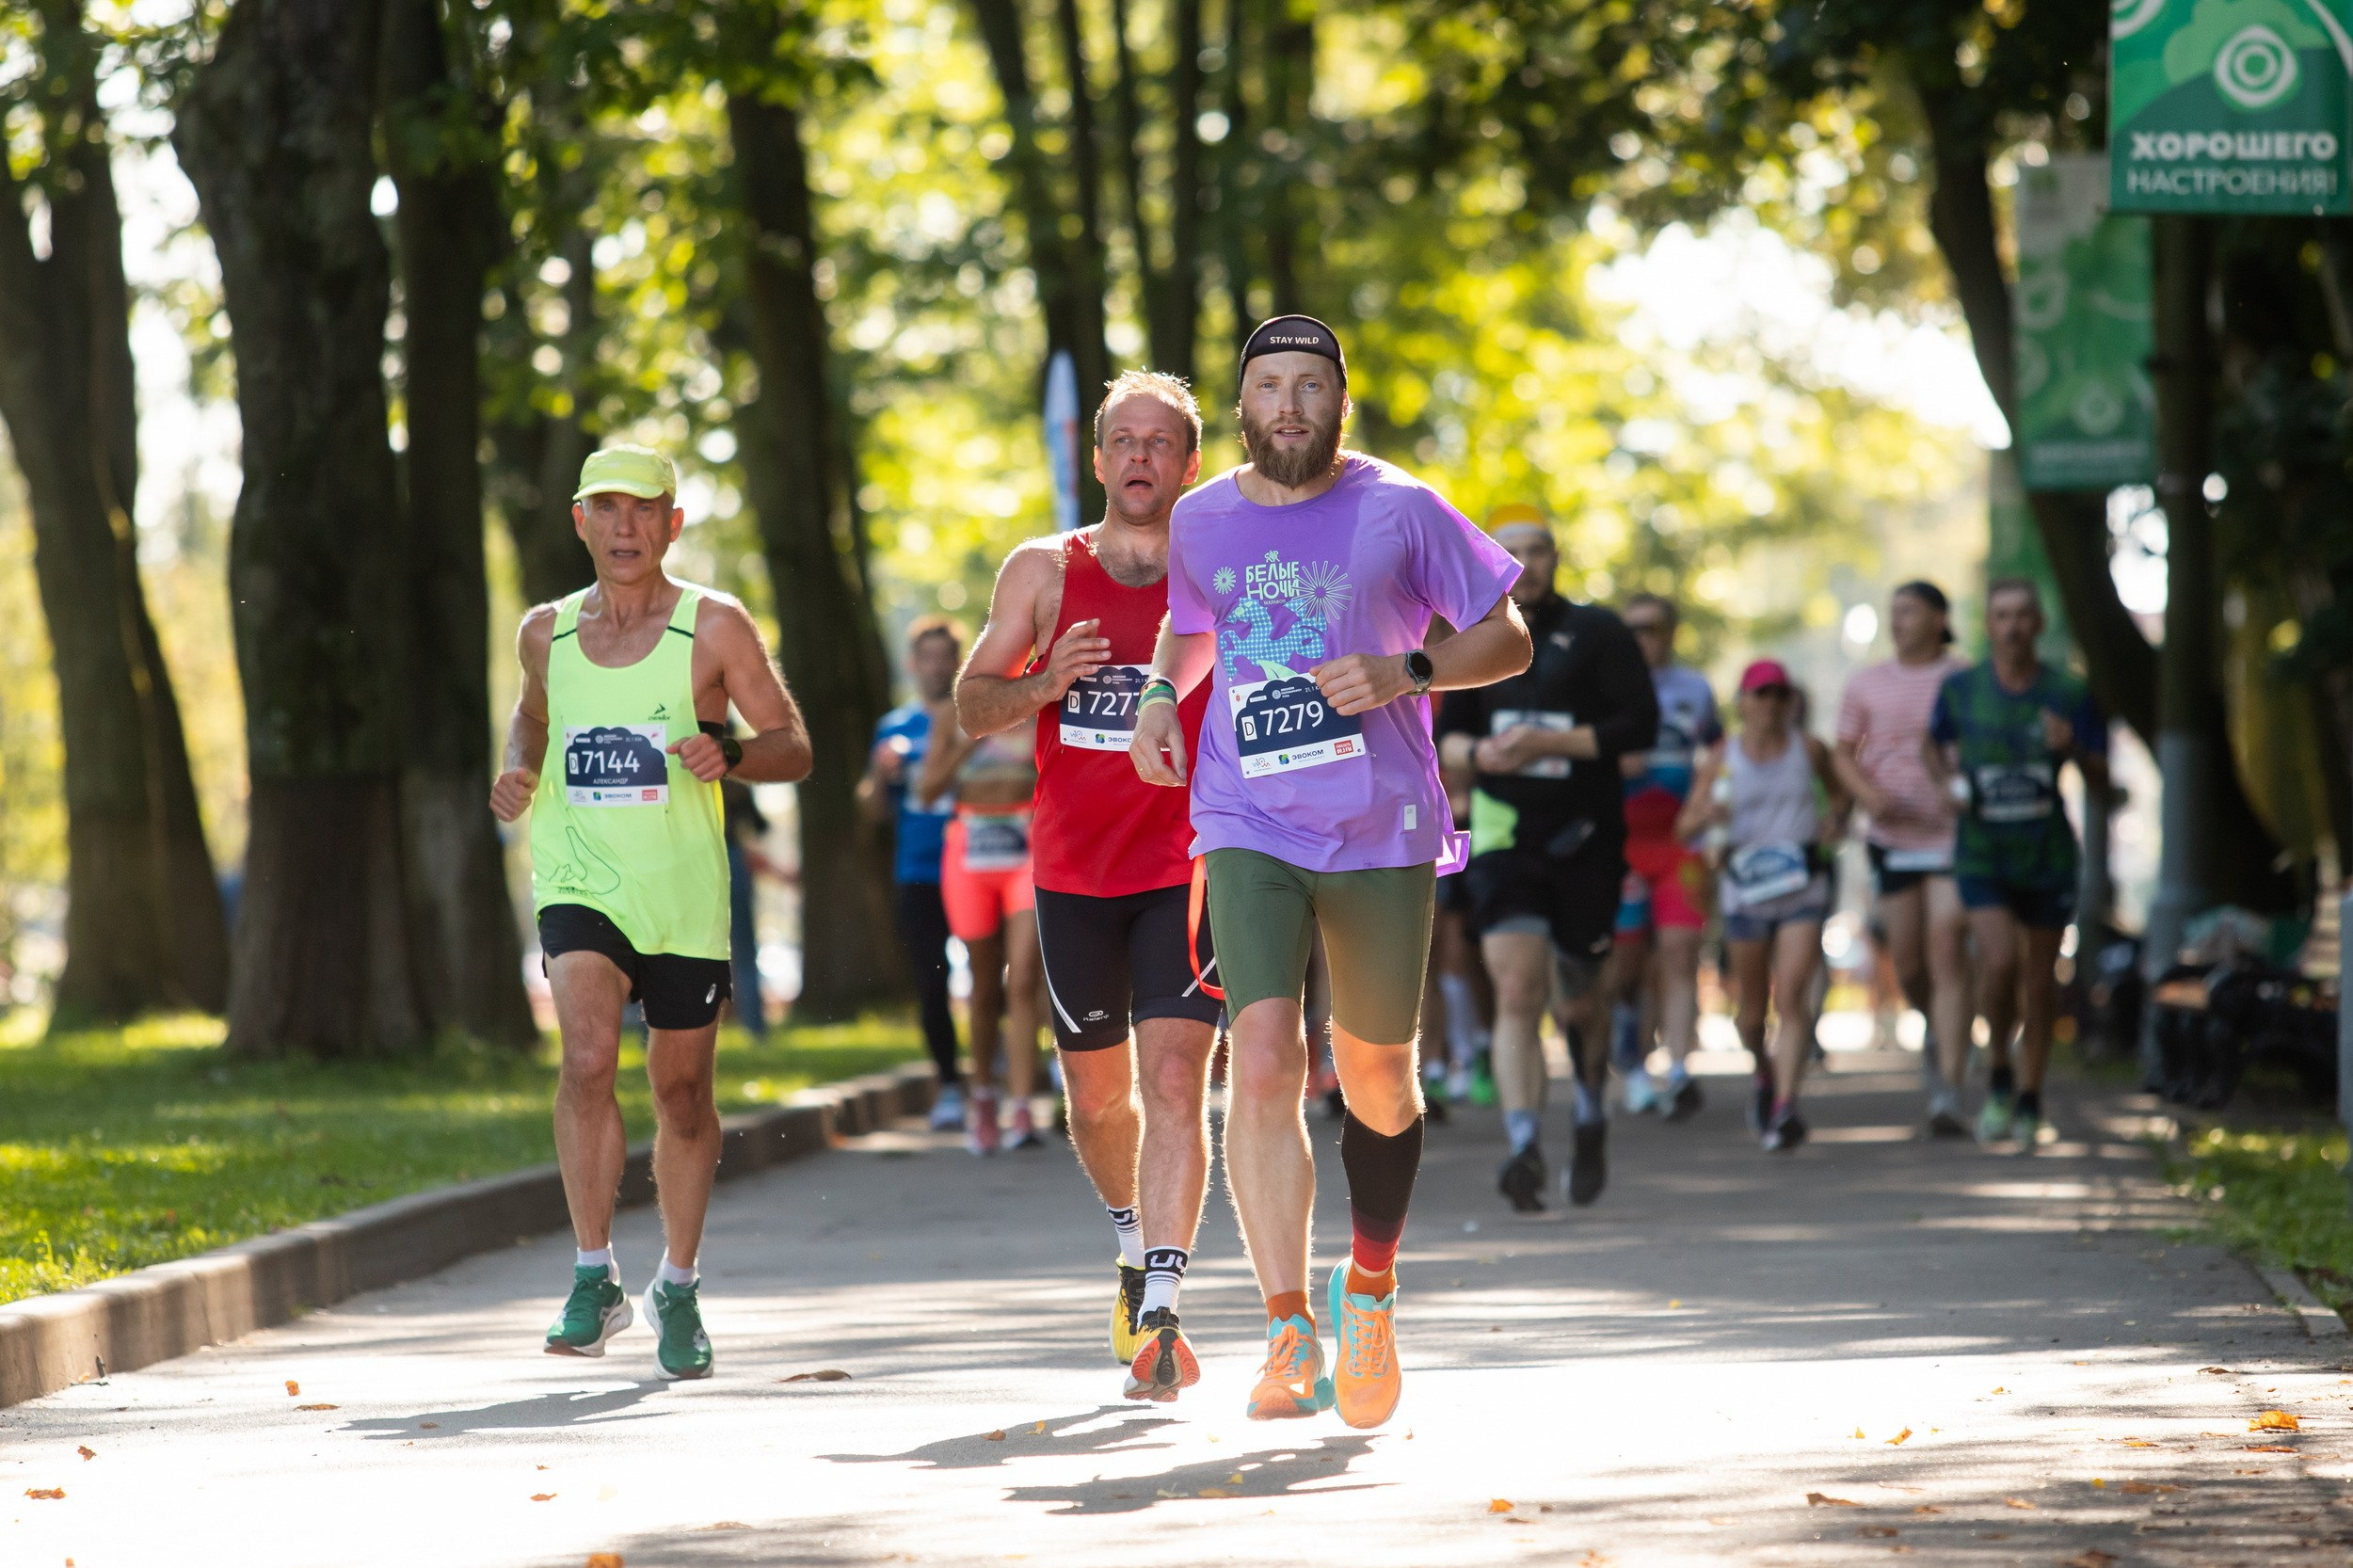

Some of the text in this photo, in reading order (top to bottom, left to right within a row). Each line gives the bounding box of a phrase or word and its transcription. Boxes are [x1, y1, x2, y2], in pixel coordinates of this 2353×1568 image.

[2130, 132, 2338, 161] ХОРОШЕГО
[1245, 561, 1299, 584] БЕЛЫЕ
[1246, 580, 1301, 600] НОЧИ
[1070, 691, 1140, 716] D 727
[1244, 701, 1324, 736] D 7279
[582, 749, 640, 774] 7144
[1292, 749, 1324, 760] ЭВОКОМ
